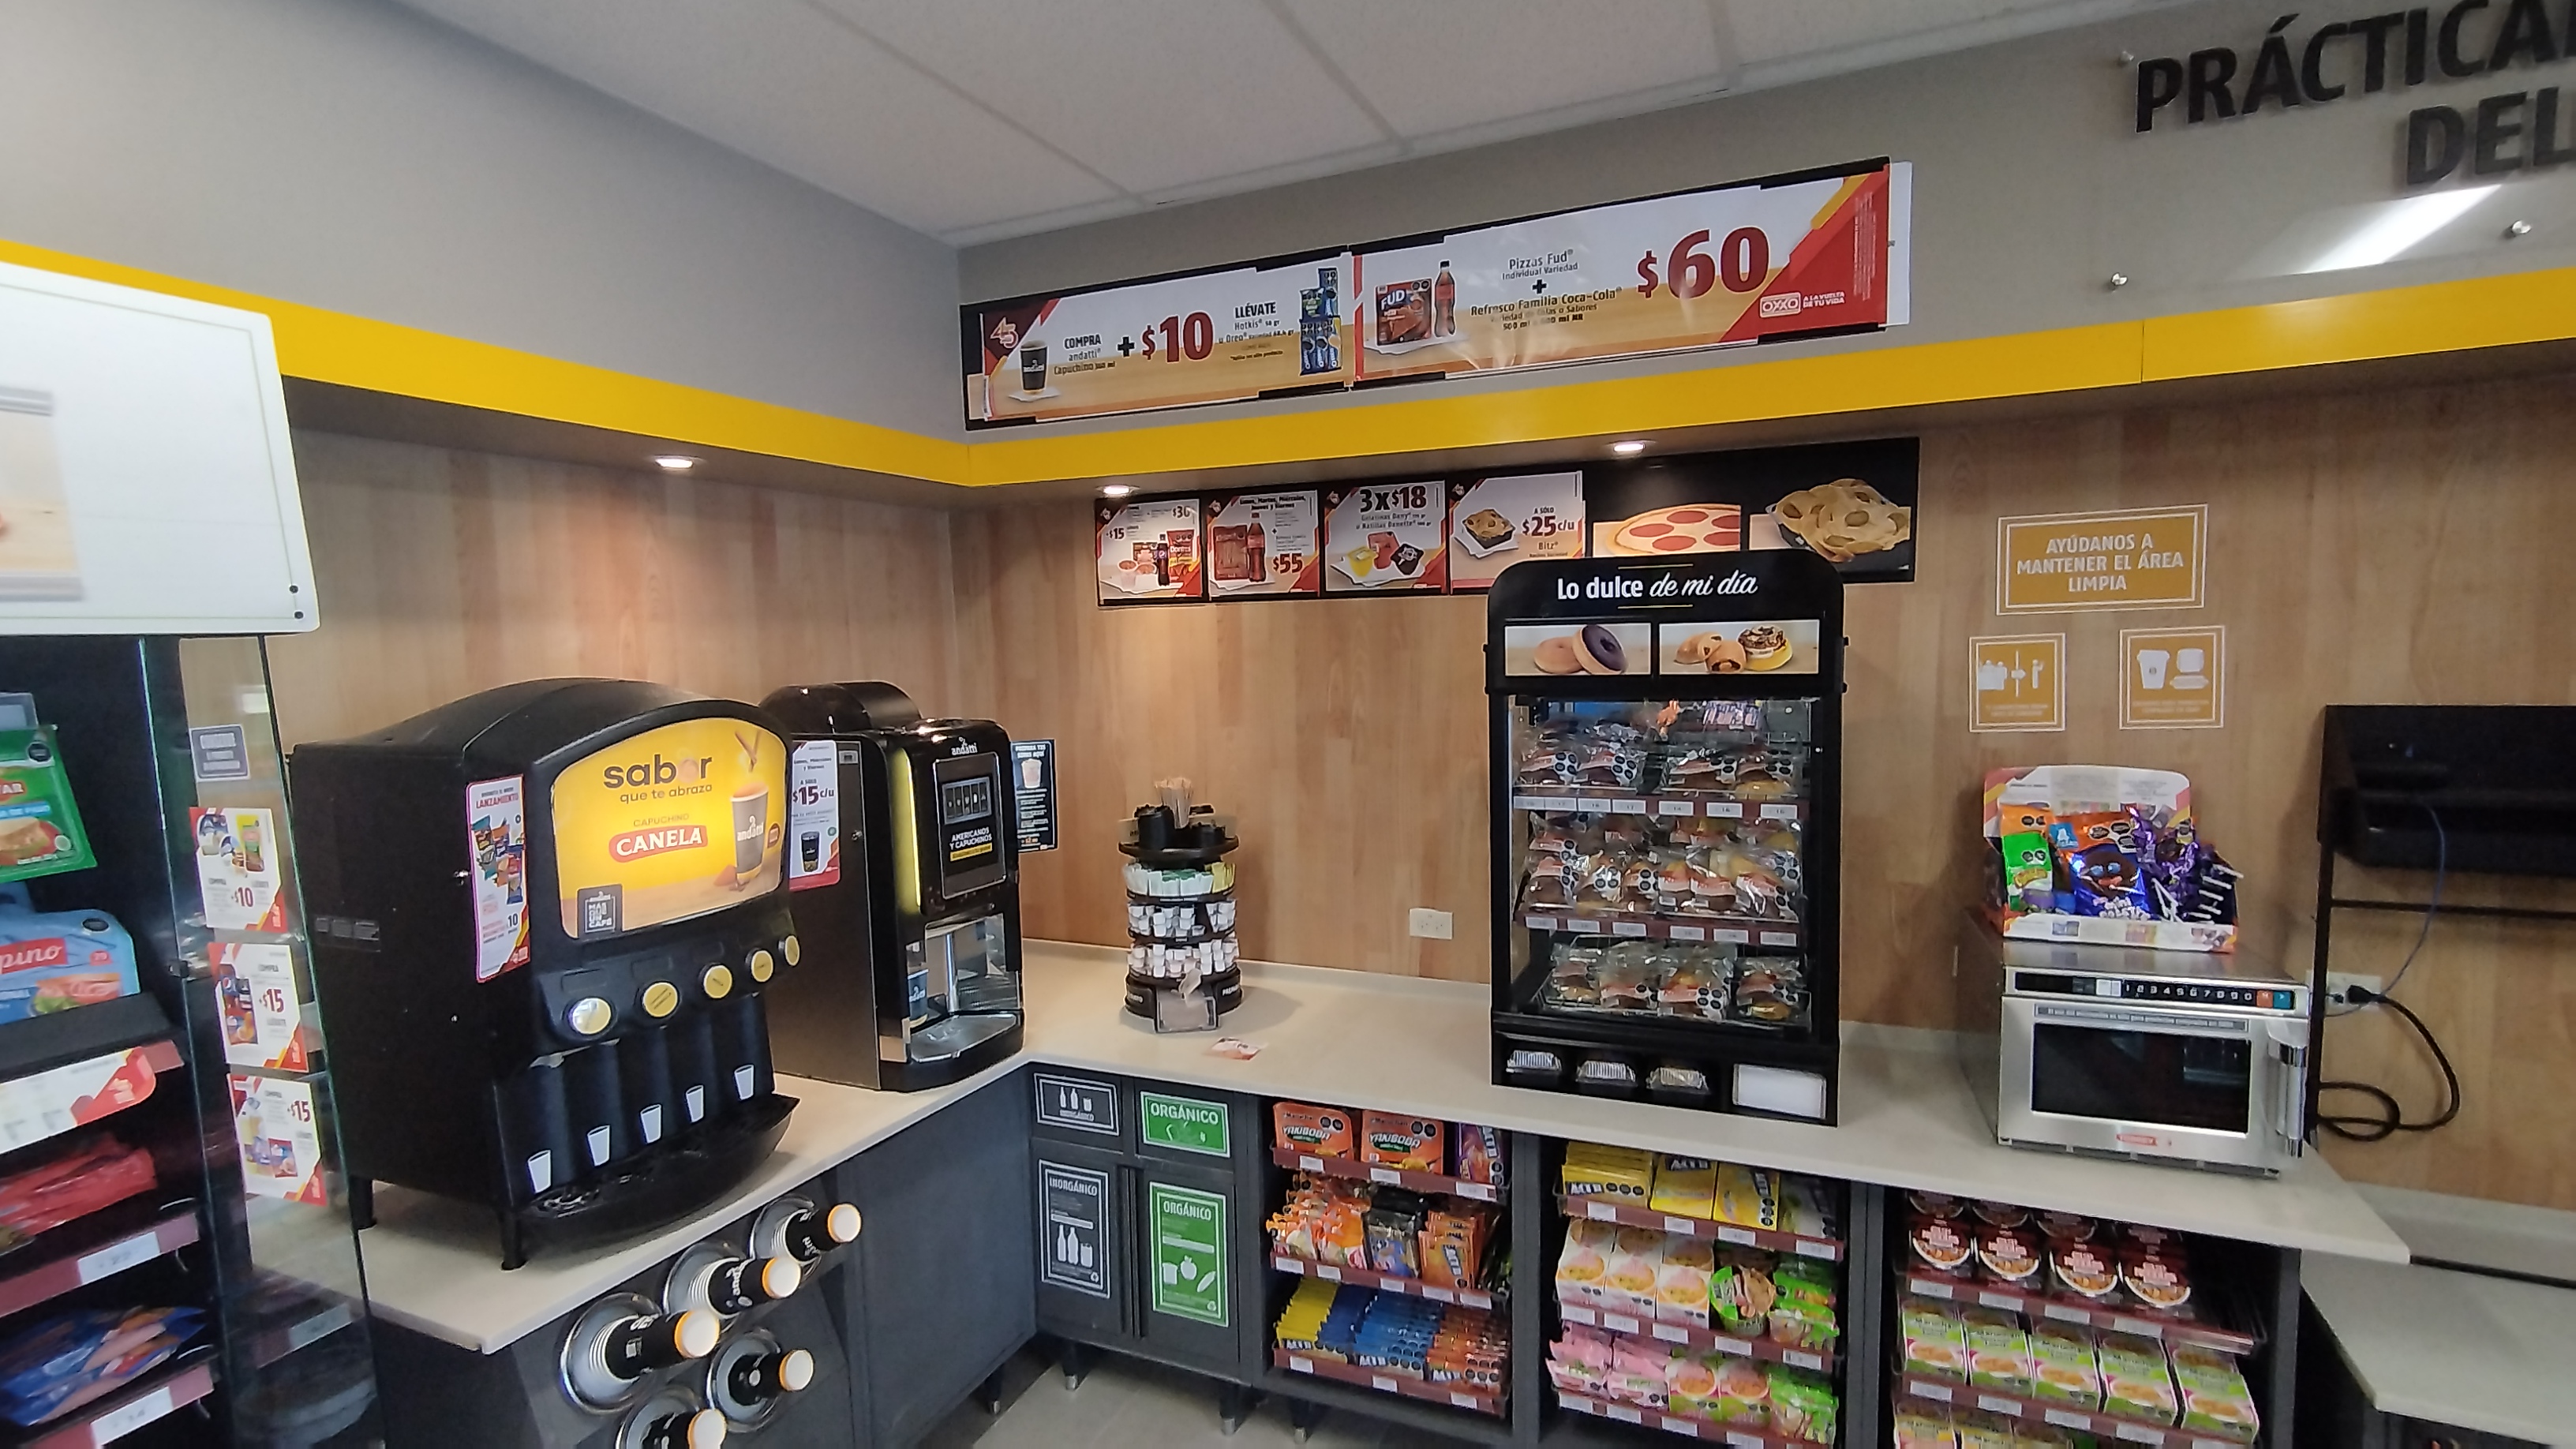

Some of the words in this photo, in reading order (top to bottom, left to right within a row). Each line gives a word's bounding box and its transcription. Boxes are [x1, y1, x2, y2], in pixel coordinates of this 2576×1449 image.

[2136, 0, 2576, 133] PRÁCTICA
[1508, 256, 1543, 270] Pizzas
[1547, 252, 1567, 264] Fud
[1637, 227, 1769, 300] $60
[1502, 268, 1541, 280] Individual
[1544, 263, 1578, 274] Variedad
[1382, 289, 1406, 311] FUD
[1518, 297, 1558, 309] Familia
[1561, 289, 1616, 304] Coca-Cola
[1567, 303, 1597, 313] Sabores
[1762, 301, 1799, 313] OXXO
[1825, 297, 1845, 305] VIDA
[1234, 301, 1277, 319] LLÉVATE
[1234, 320, 1259, 331] Hotkis
[1064, 335, 1102, 350] COMPRA
[1141, 312, 1214, 363] $10
[1226, 334, 1244, 343] Oreo
[1069, 350, 1098, 361] andatti
[1522, 515, 1556, 537] $25
[1557, 519, 1574, 531] c/u
[2046, 534, 2136, 553] AYÚDANOS
[2141, 533, 2153, 549] A
[1272, 552, 1303, 575] $55
[2016, 556, 2106, 575] MANTENER
[2114, 554, 2132, 571] EL
[2137, 550, 2184, 569] ÁREA
[1557, 578, 1580, 599] Lo
[1586, 576, 1643, 598] dulce
[1649, 572, 1679, 597] de
[1681, 575, 1713, 596] mi
[1717, 569, 1758, 594] día
[2069, 575, 2127, 592] LIMPIA
[603, 754, 713, 789] sabor
[620, 792, 648, 803] que
[651, 790, 665, 799] te
[668, 783, 713, 797] abraza
[792, 785, 819, 805] $15
[820, 788, 835, 798] c/u
[633, 814, 690, 827] CAPUCHINO
[616, 827, 703, 856] CANELA
[951, 826, 990, 843] AMERICANOS
[507, 913, 519, 927] 10
[1151, 1102, 1219, 1125] ORGÁNICO
[1049, 1177, 1098, 1197] INORGÁNICO
[1163, 1200, 1212, 1221] ORGÁNICO
